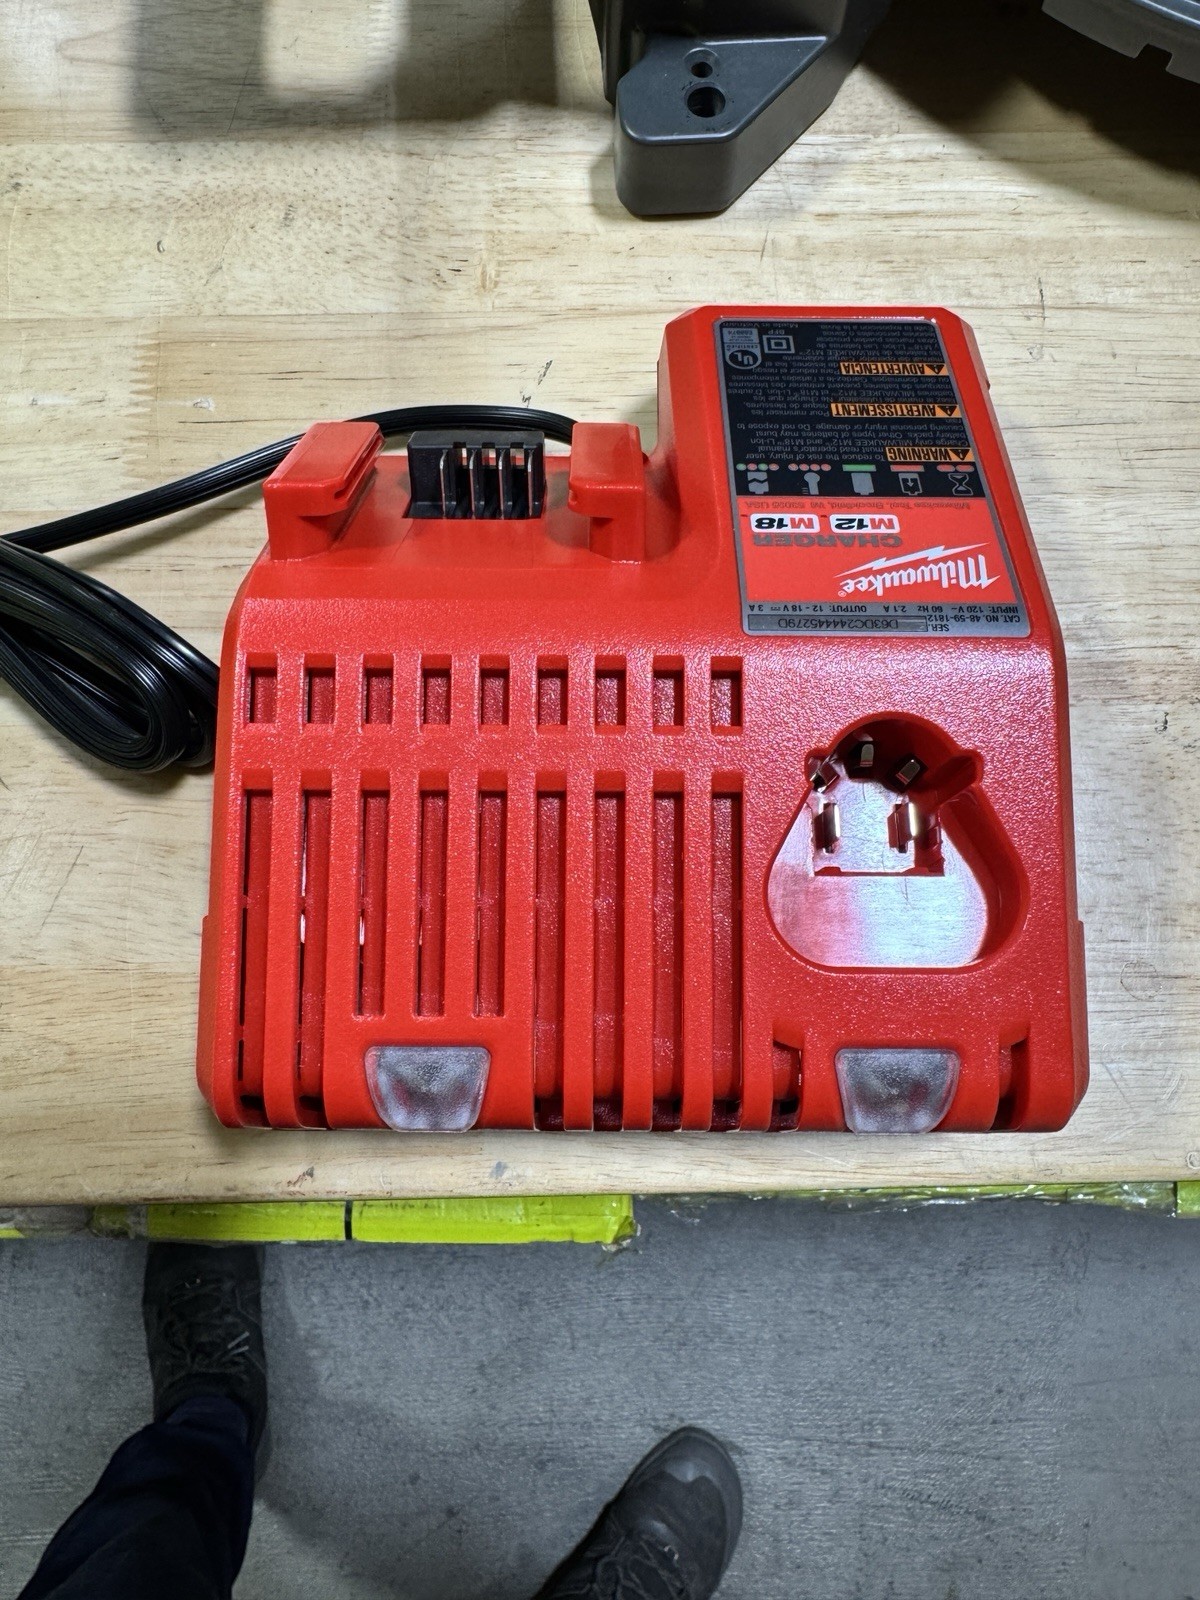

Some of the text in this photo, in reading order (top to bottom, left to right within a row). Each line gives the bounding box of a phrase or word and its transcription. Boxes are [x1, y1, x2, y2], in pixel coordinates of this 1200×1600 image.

[841, 363, 925, 375] ADVERTENCIA
[834, 404, 936, 417] AVERTISSEMENT
[888, 448, 952, 461] WARNING
[754, 517, 896, 530] M12 M18
[754, 534, 903, 548] CHARGER
[927, 614, 981, 622] 48-59-1812
